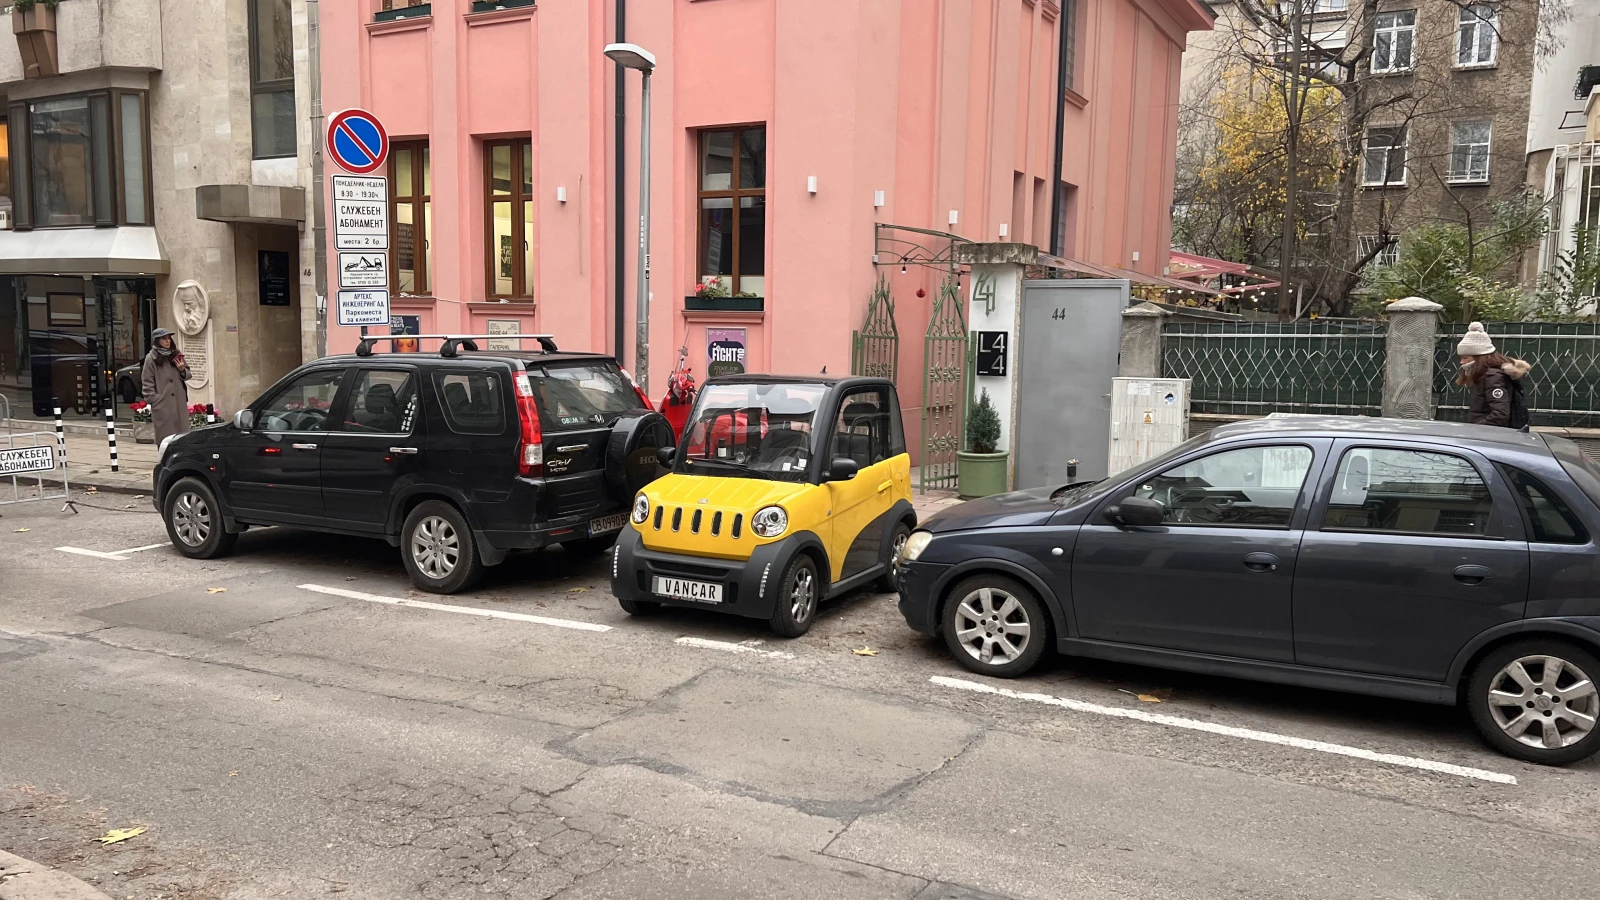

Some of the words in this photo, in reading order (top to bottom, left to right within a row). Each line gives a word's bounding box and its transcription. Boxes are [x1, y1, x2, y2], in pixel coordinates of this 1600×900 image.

[341, 206, 380, 216] СЛУЖЕБЕН
[340, 218, 384, 228] АБОНАМЕНТ
[1052, 308, 1066, 320] 44
[712, 348, 737, 362] FIGHT
[991, 354, 1004, 374] 4
[0, 449, 48, 461] СЛУЖЕБЕН
[0, 459, 51, 471] АБОНАМЕНТ
[547, 458, 572, 466] CR-V
[666, 579, 716, 599] VANCAR
